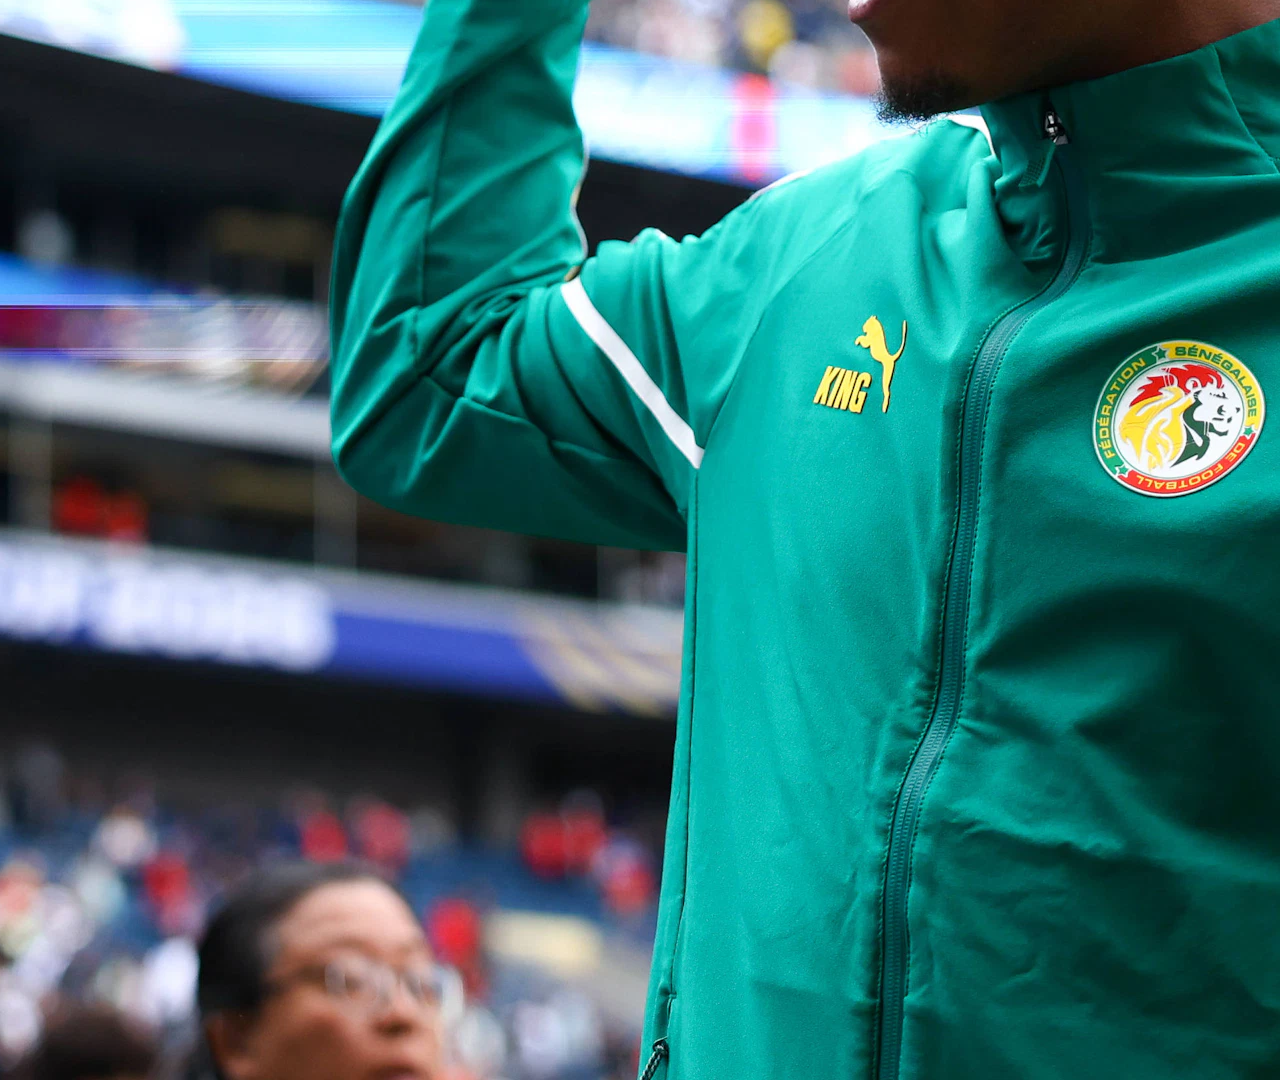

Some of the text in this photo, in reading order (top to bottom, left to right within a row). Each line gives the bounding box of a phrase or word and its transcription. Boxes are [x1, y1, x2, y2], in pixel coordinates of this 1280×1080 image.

[813, 365, 872, 413] KING
[1097, 345, 1257, 490] FÉDÉRATION SÉNÉGALAISE DE FOOTBALL
